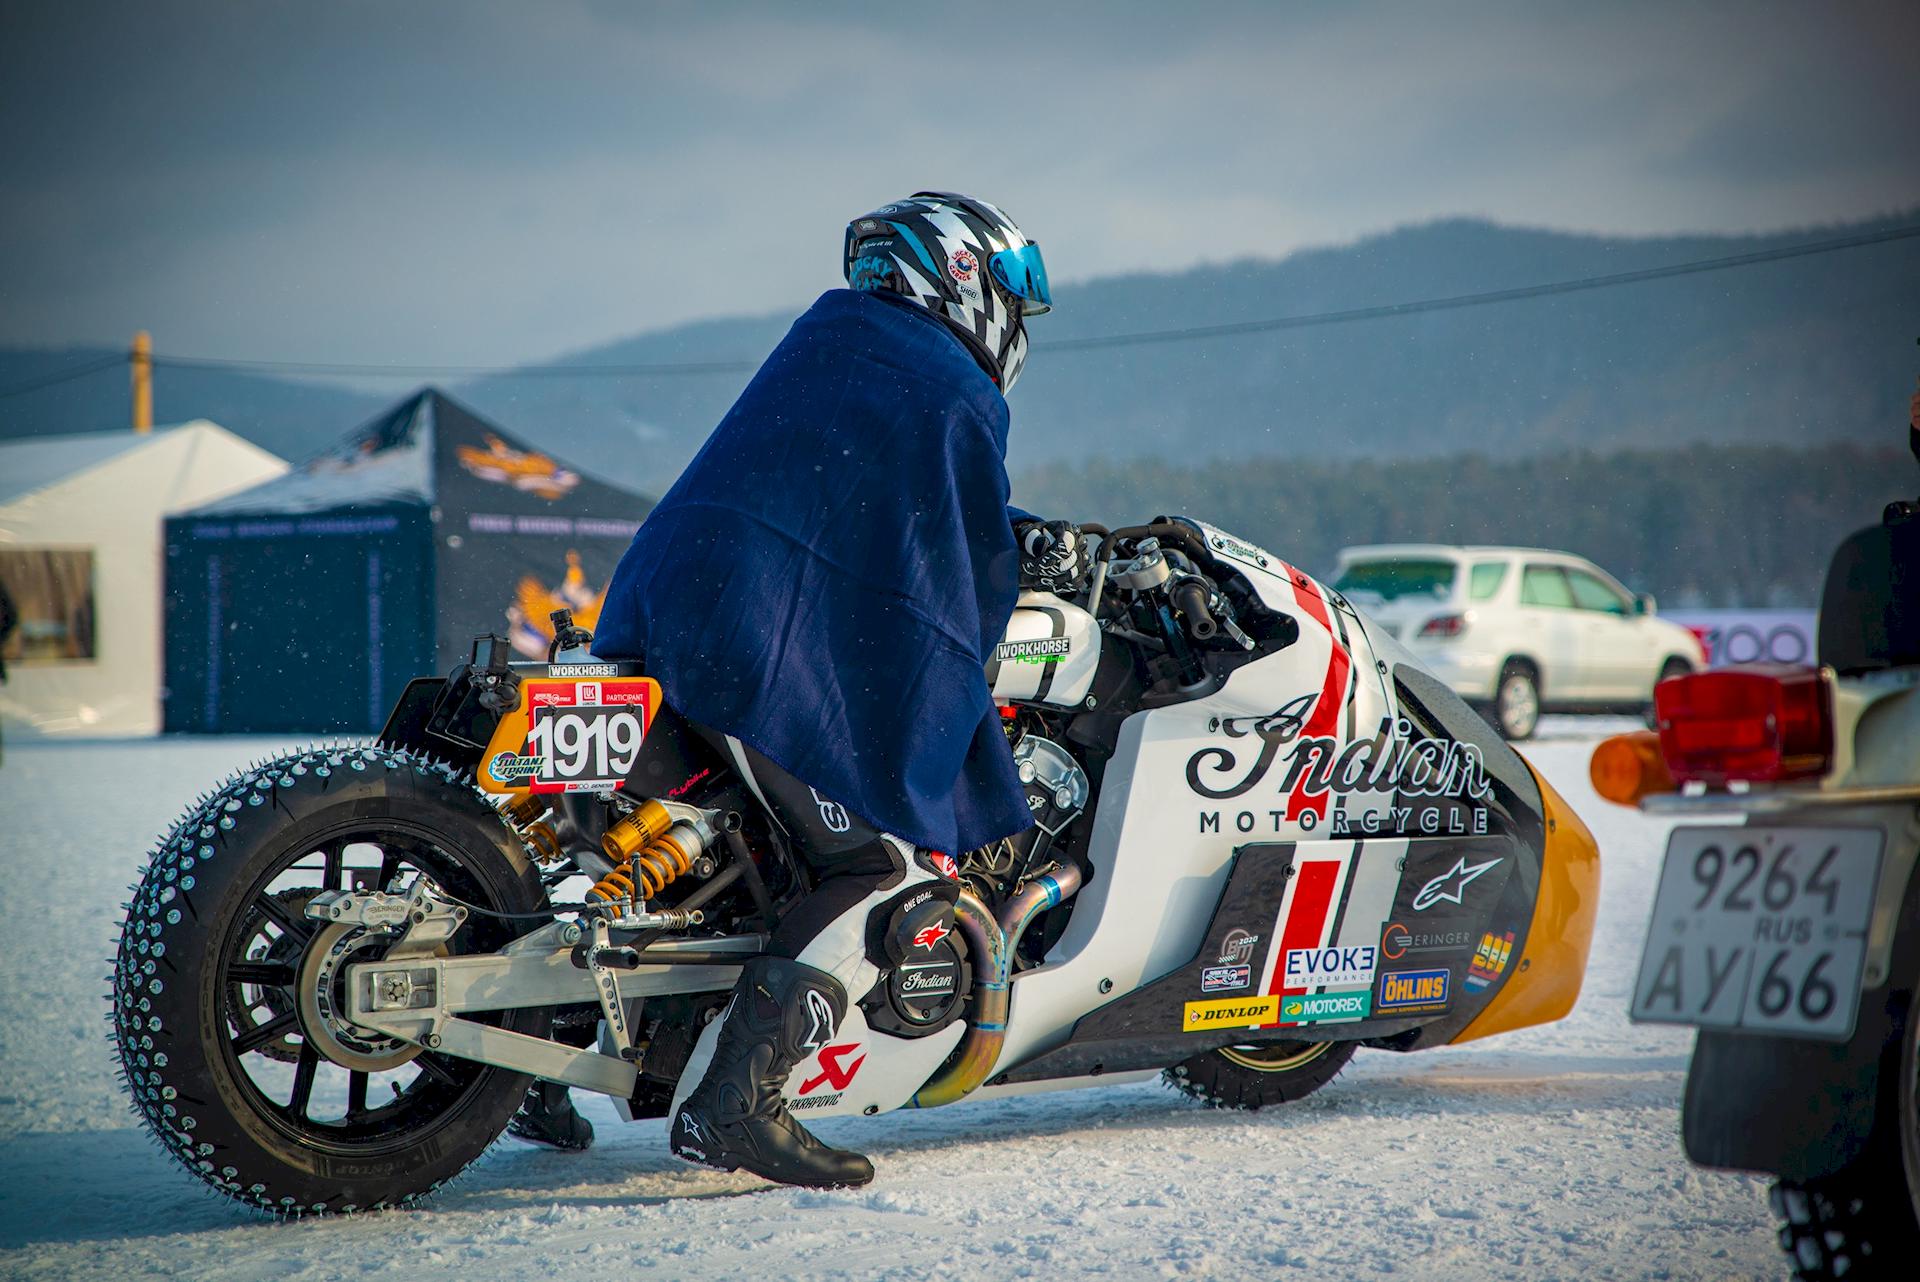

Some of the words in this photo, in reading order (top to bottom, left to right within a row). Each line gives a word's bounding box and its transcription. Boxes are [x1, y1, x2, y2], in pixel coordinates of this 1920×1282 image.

[952, 251, 973, 260] LUCKY
[950, 264, 972, 281] GARAGE
[960, 285, 977, 299] SHOEI
[1000, 639, 1069, 658] WORKHORSE
[1705, 622, 1808, 666] 100
[551, 666, 616, 676] WORKHORSE
[606, 694, 643, 702] PARTICIPANT
[528, 712, 642, 778] 1919
[1185, 693, 1490, 799] Indian
[499, 757, 546, 766] SULTANS
[503, 766, 542, 775] SPRINT
[1200, 807, 1488, 833] MOTORCYCLE
[1693, 844, 1841, 915] 9264
[903, 897, 917, 913] ONE
[916, 889, 934, 904] GOAL
[1753, 917, 1813, 944] RUS
[1239, 935, 1259, 945] 2020
[902, 971, 953, 991] Indian
[1286, 973, 1373, 985] PERFORMANCE
[1757, 950, 1836, 1022] 66
[1384, 975, 1444, 1002] ÖHLINS
[1203, 1005, 1270, 1020] DUNLOP
[1303, 997, 1363, 1015] MOTOREX
